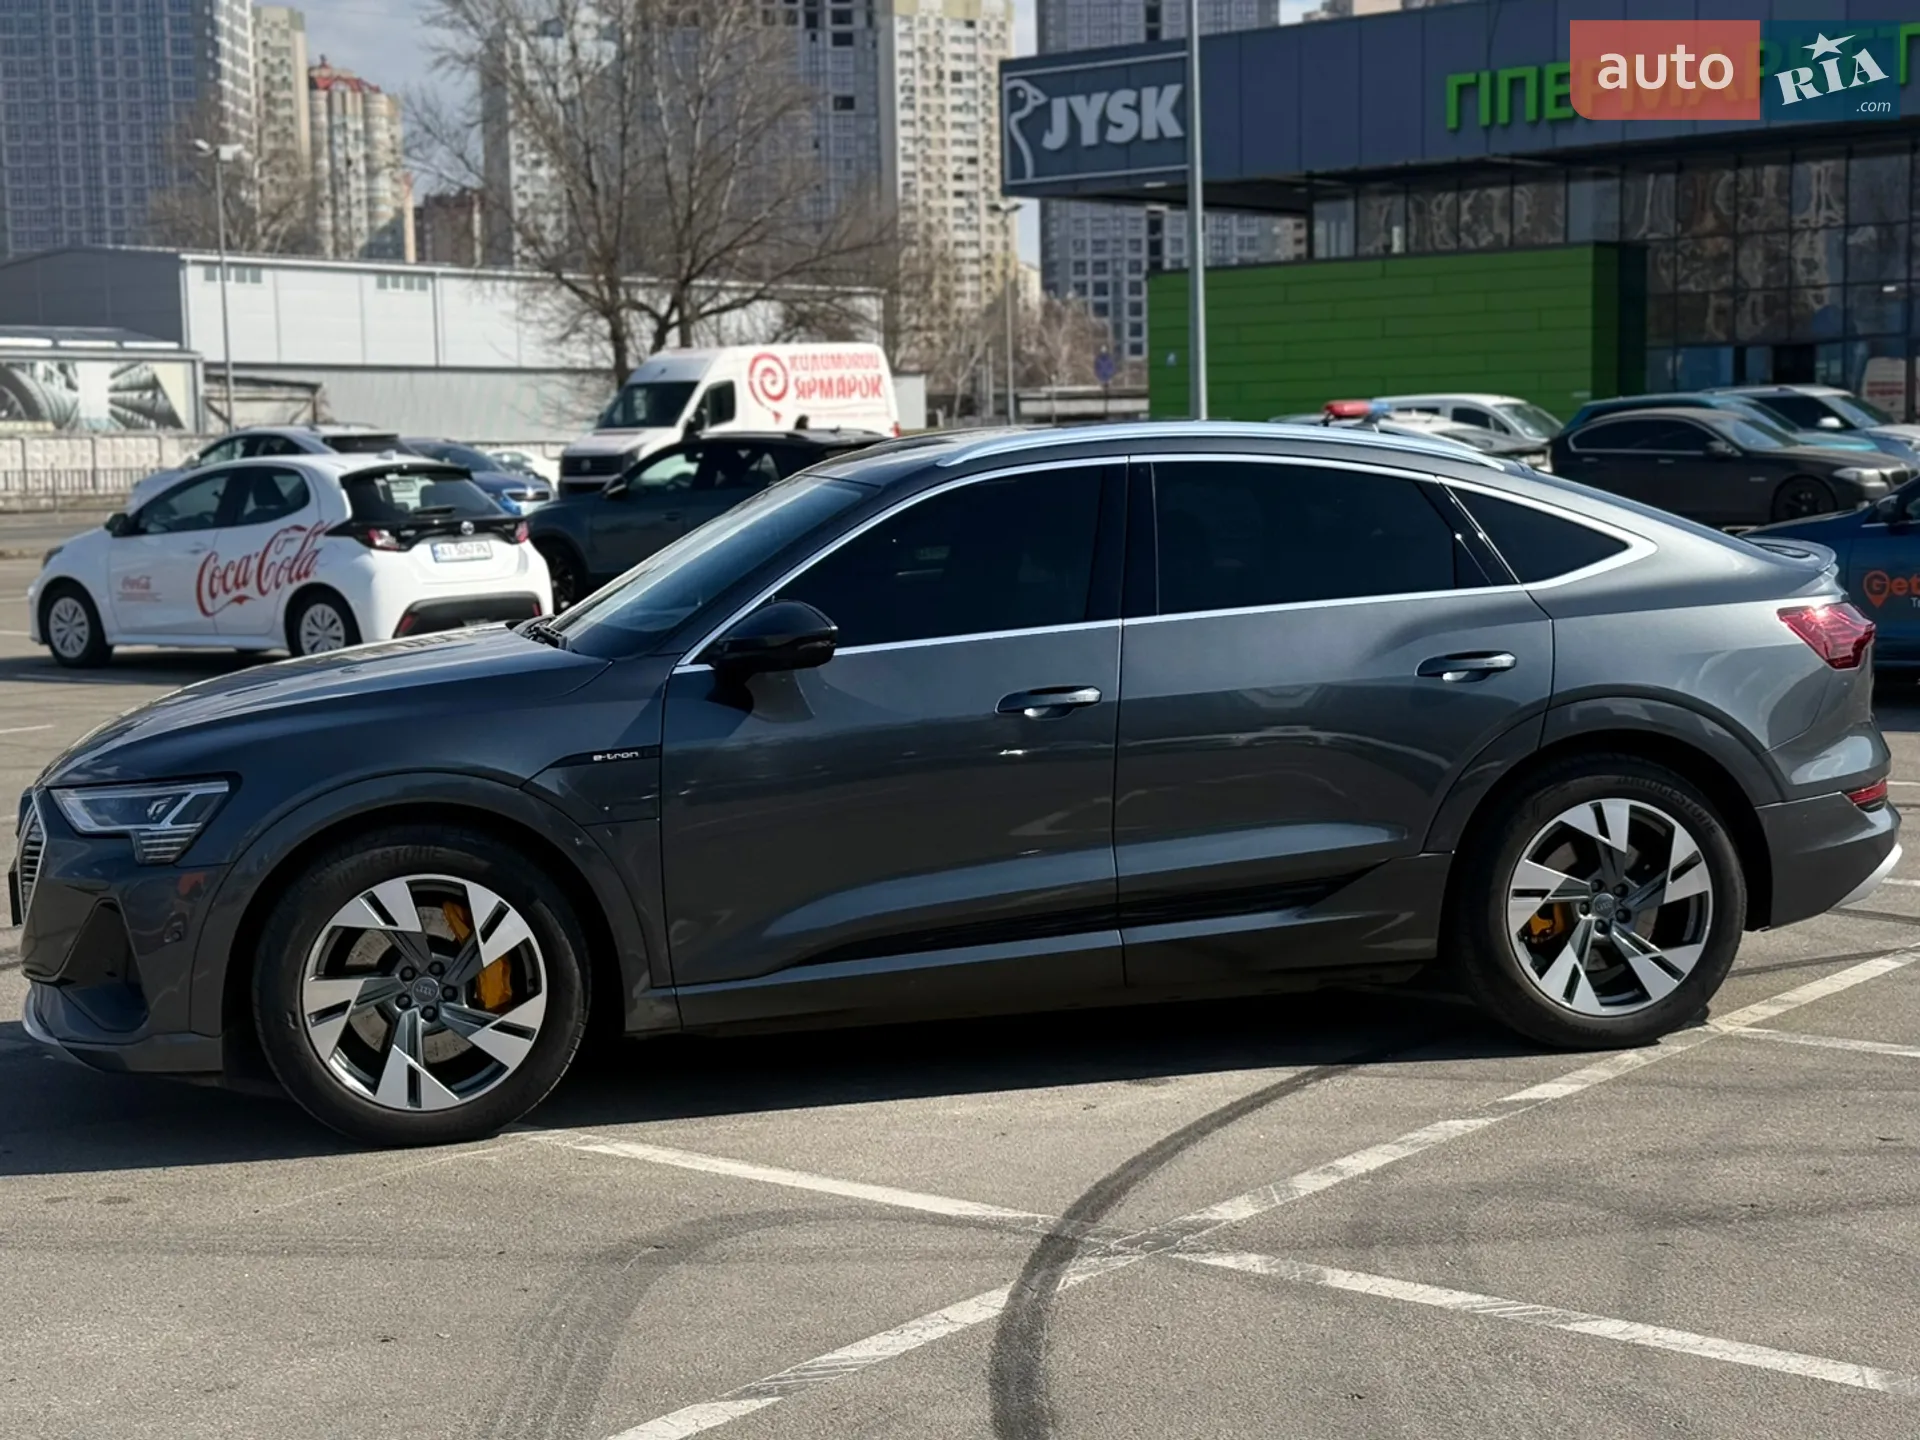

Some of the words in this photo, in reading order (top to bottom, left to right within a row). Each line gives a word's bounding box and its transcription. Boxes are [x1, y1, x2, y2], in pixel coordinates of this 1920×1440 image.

[1041, 83, 1185, 151] JYSK
[794, 374, 883, 400] ЯРМАРОК
[592, 751, 640, 762] e-tron
